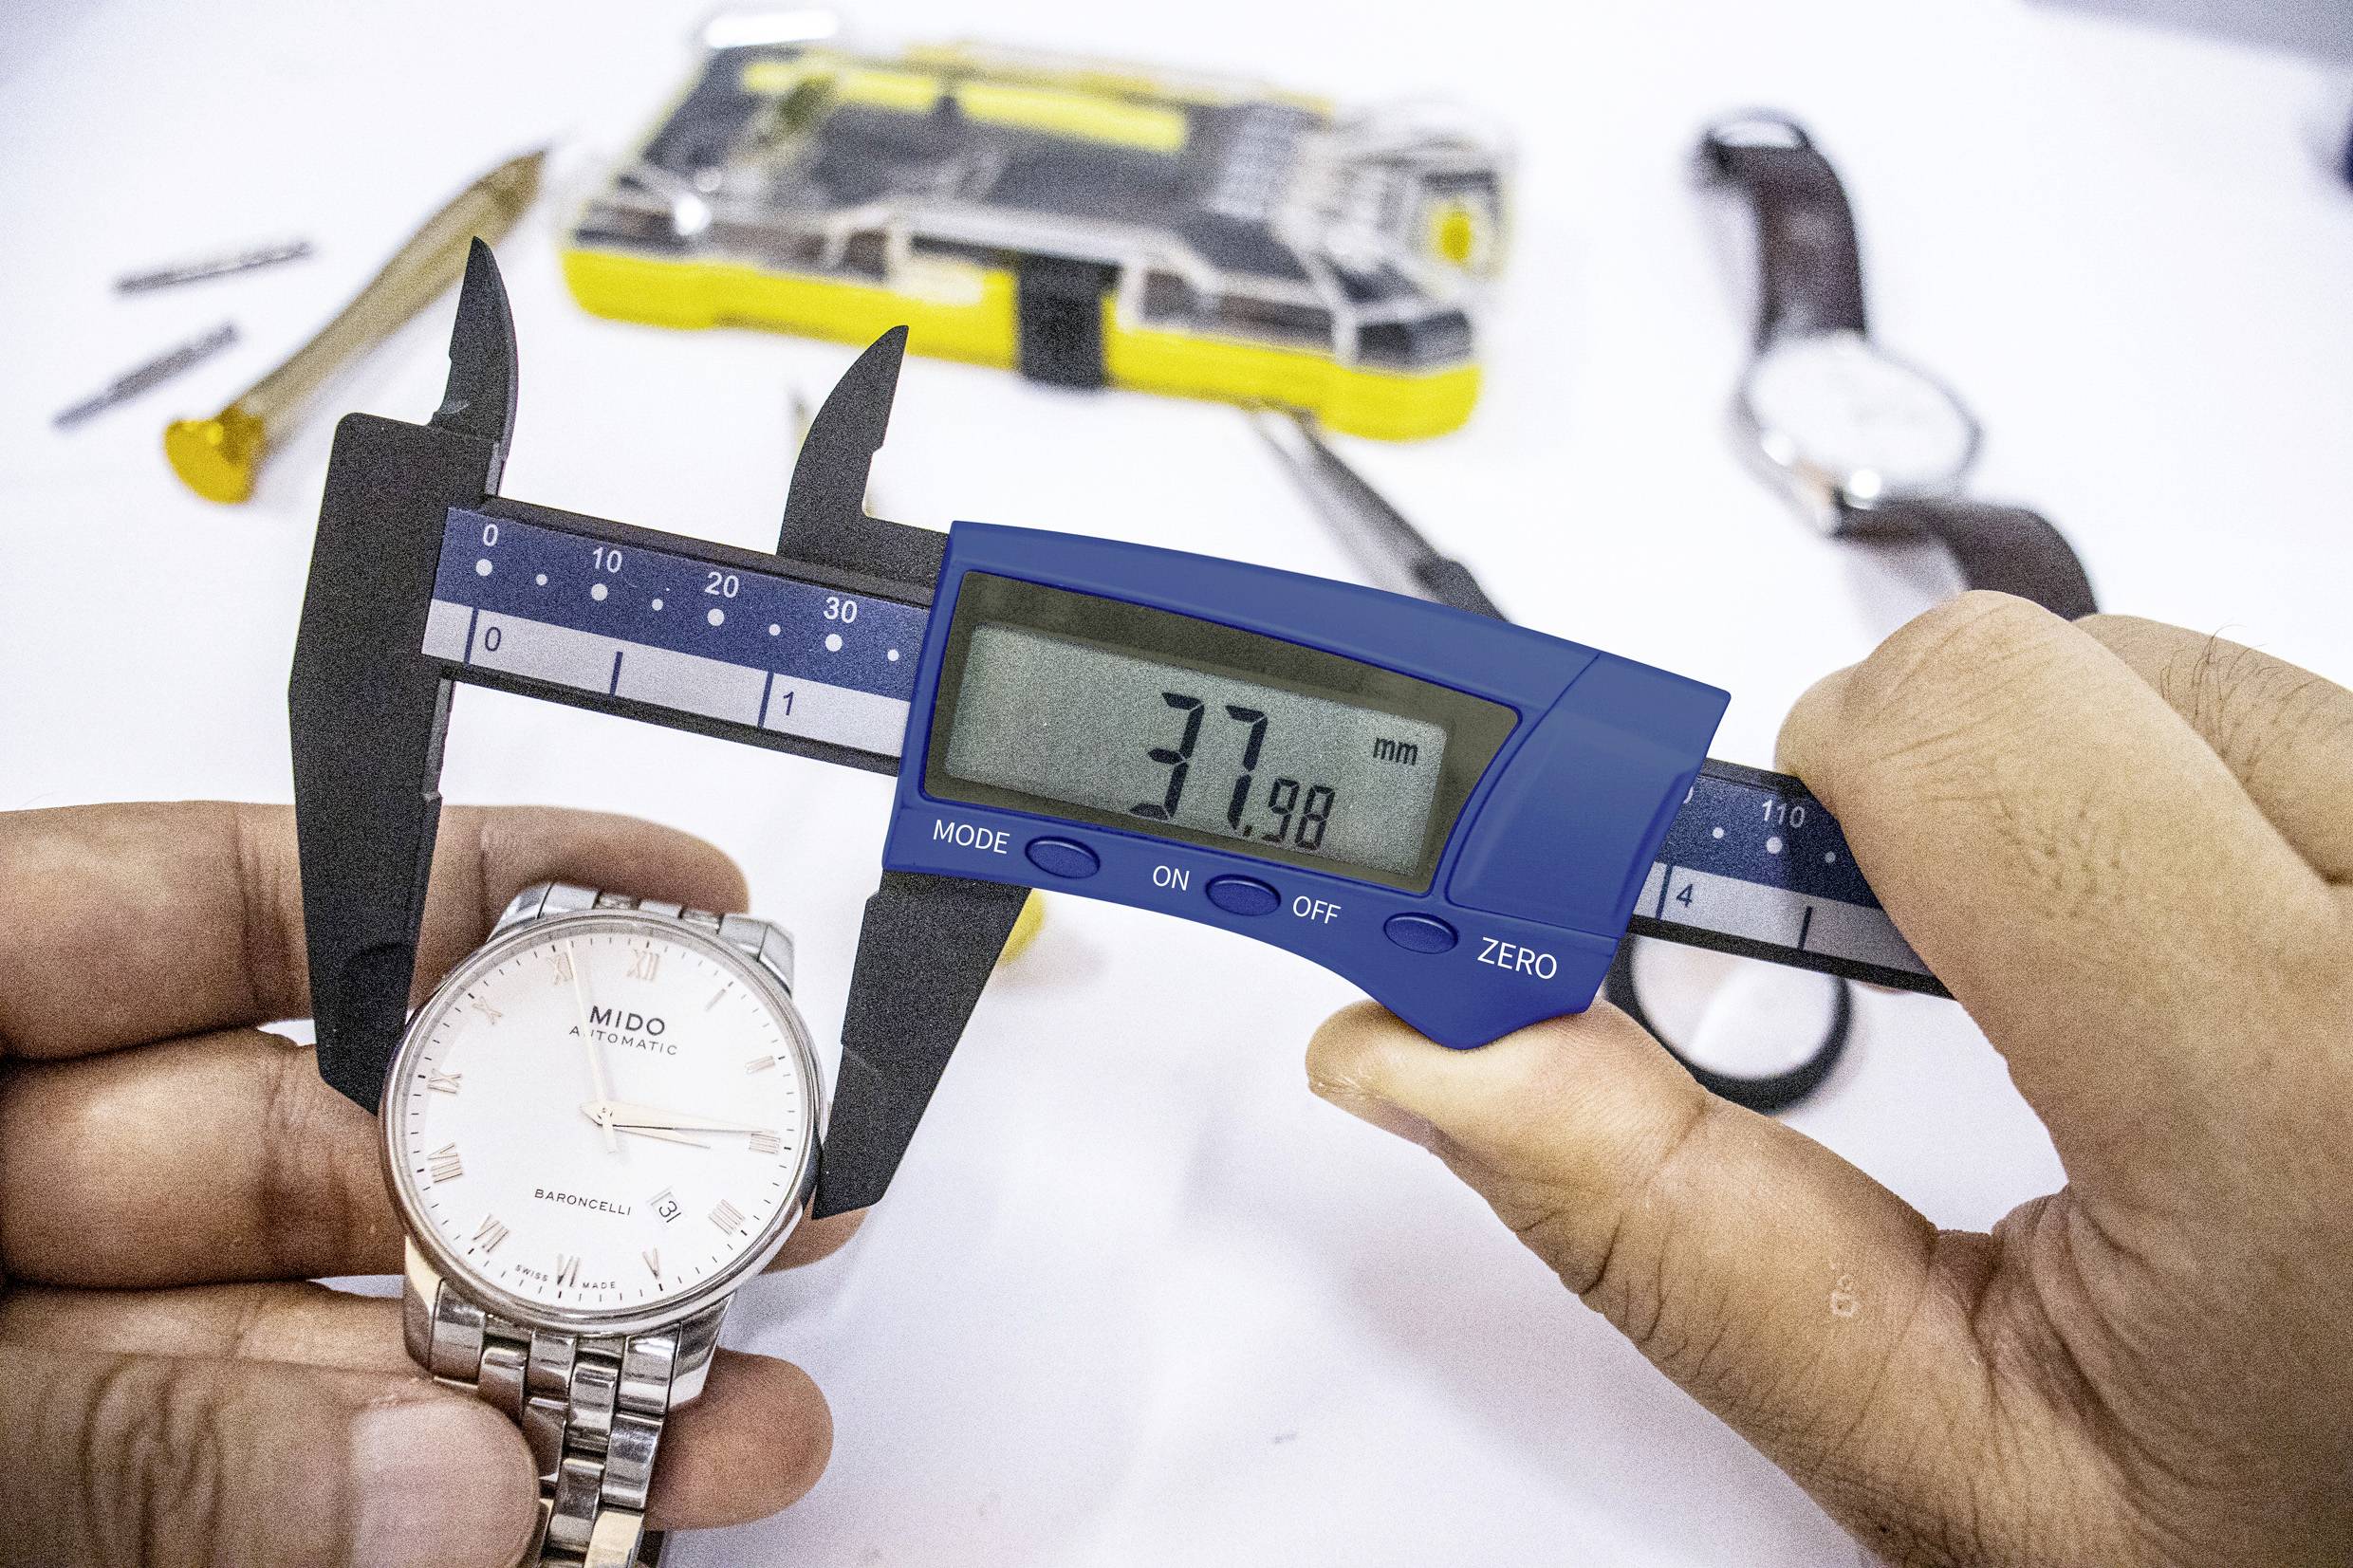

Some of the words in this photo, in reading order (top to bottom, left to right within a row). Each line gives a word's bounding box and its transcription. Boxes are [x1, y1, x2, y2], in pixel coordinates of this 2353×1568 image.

[482, 524, 498, 547] 0
[591, 547, 622, 573] 10
[705, 571, 739, 599] 20
[823, 597, 857, 623] 30
[484, 626, 502, 653] 0
[783, 691, 794, 716] 1
[1130, 692, 1335, 852] 37.98
[1372, 735, 1417, 766] mm
[1761, 799, 1805, 828] 110
[933, 819, 1010, 855] MODE
[1152, 865, 1190, 892] ON
[1292, 895, 1341, 925] OFF
[1676, 883, 1694, 908] 4
[1477, 937, 1558, 980] ZERO
[589, 1005, 665, 1036] MIDO
[534, 1189, 632, 1216] BARONCELLI
[658, 1200, 682, 1224] 31
[515, 1264, 548, 1282] SWISS
[582, 1281, 616, 1289] MADE
